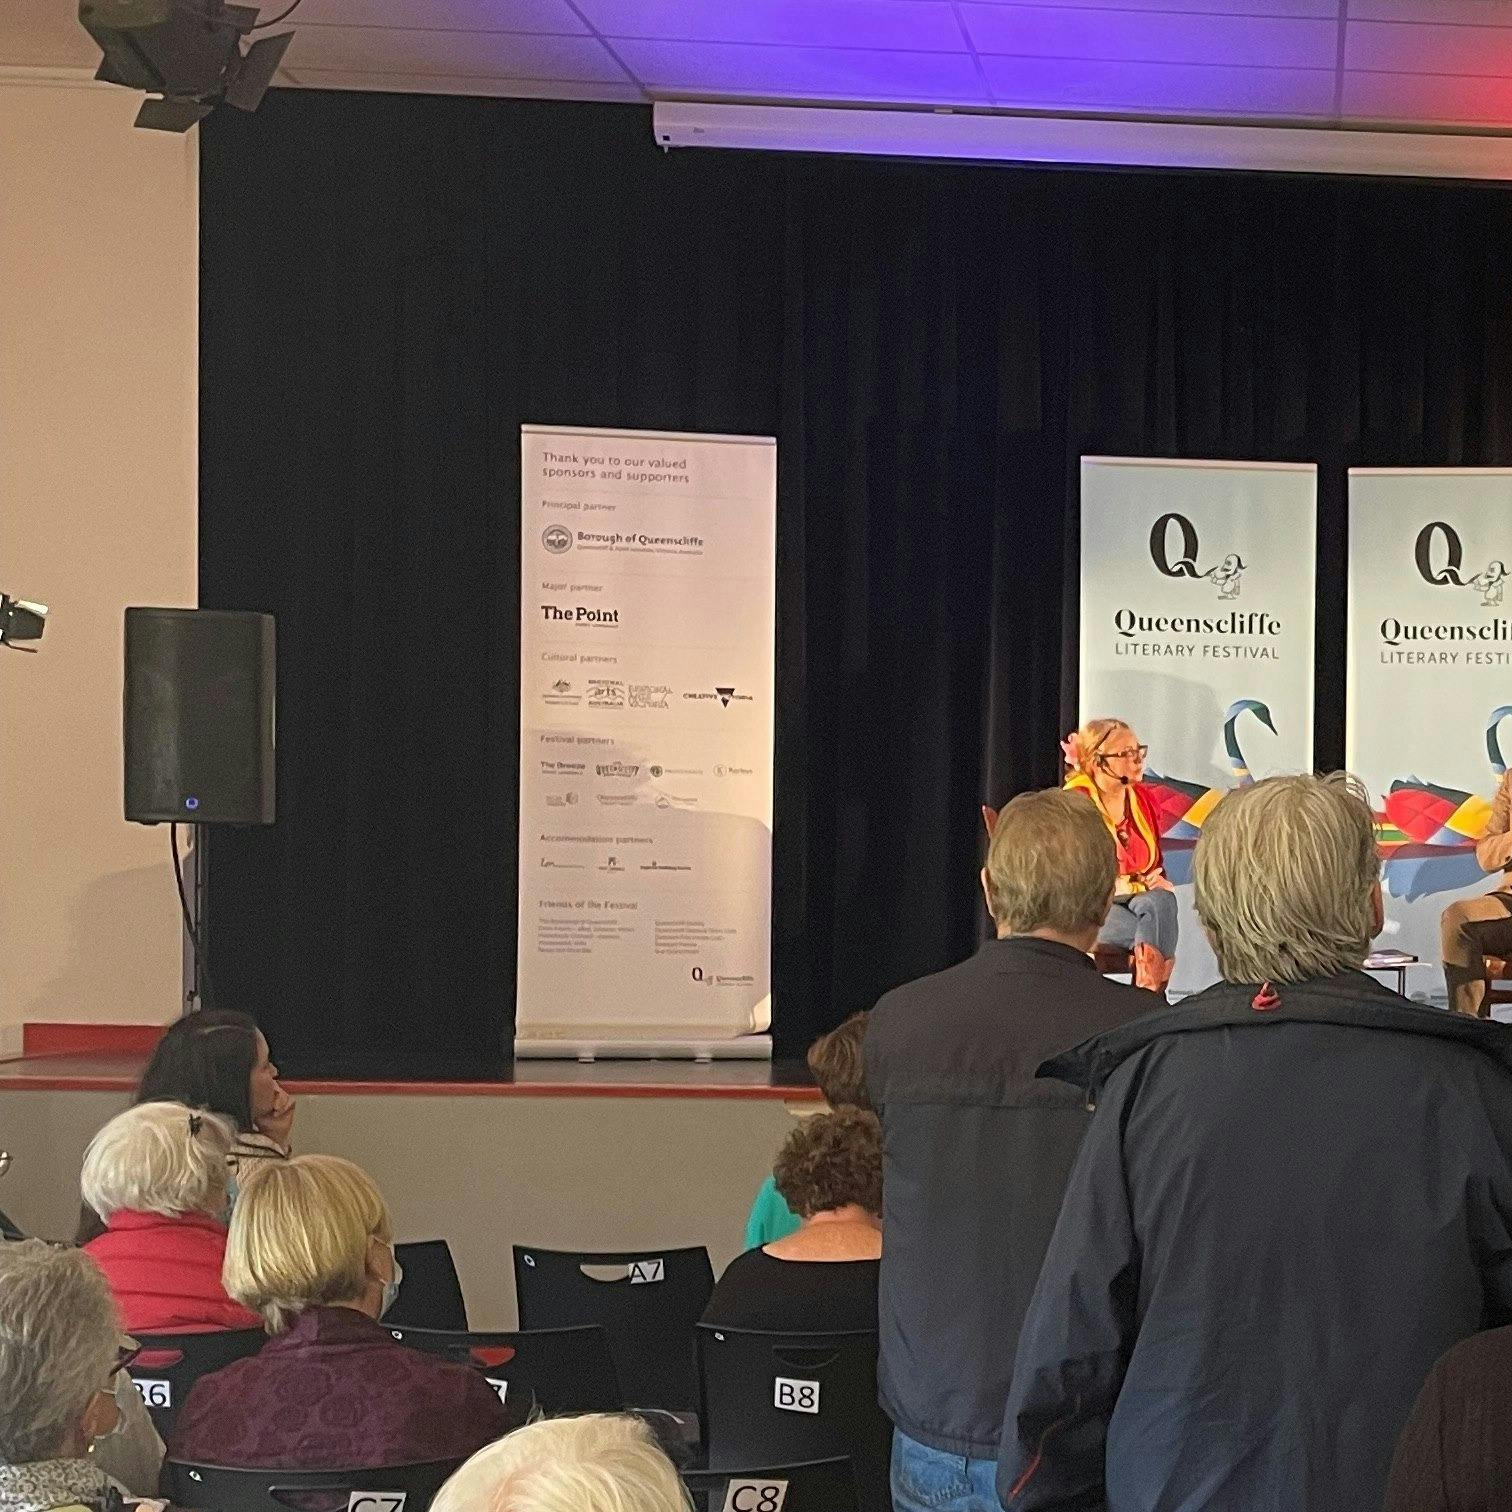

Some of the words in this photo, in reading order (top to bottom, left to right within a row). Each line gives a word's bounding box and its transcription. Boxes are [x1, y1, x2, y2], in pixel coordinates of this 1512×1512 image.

[542, 451, 579, 464] Thank
[582, 456, 605, 466] you
[608, 457, 621, 466] to
[624, 458, 645, 468] our
[648, 459, 687, 469] valued
[542, 467, 596, 479] sponsors
[600, 470, 622, 480] and
[626, 472, 690, 484] supporters
[541, 500, 581, 511] Principal
[583, 503, 617, 512] partner
[577, 531, 623, 545] Borough
[625, 533, 637, 543] of
[638, 534, 704, 547] Queenscliffe
[1150, 513, 1219, 579] Q
[1415, 521, 1483, 586] Q
[541, 605, 573, 620] The
[575, 606, 619, 623] Point
[1114, 608, 1282, 638] Queenscliffe
[1115, 642, 1195, 657] LITERARY
[1202, 644, 1280, 660] FESTIVAL
[1380, 650, 1459, 665] LITERARY
[629, 1261, 662, 1281] A7
[778, 1382, 815, 1408] B8
